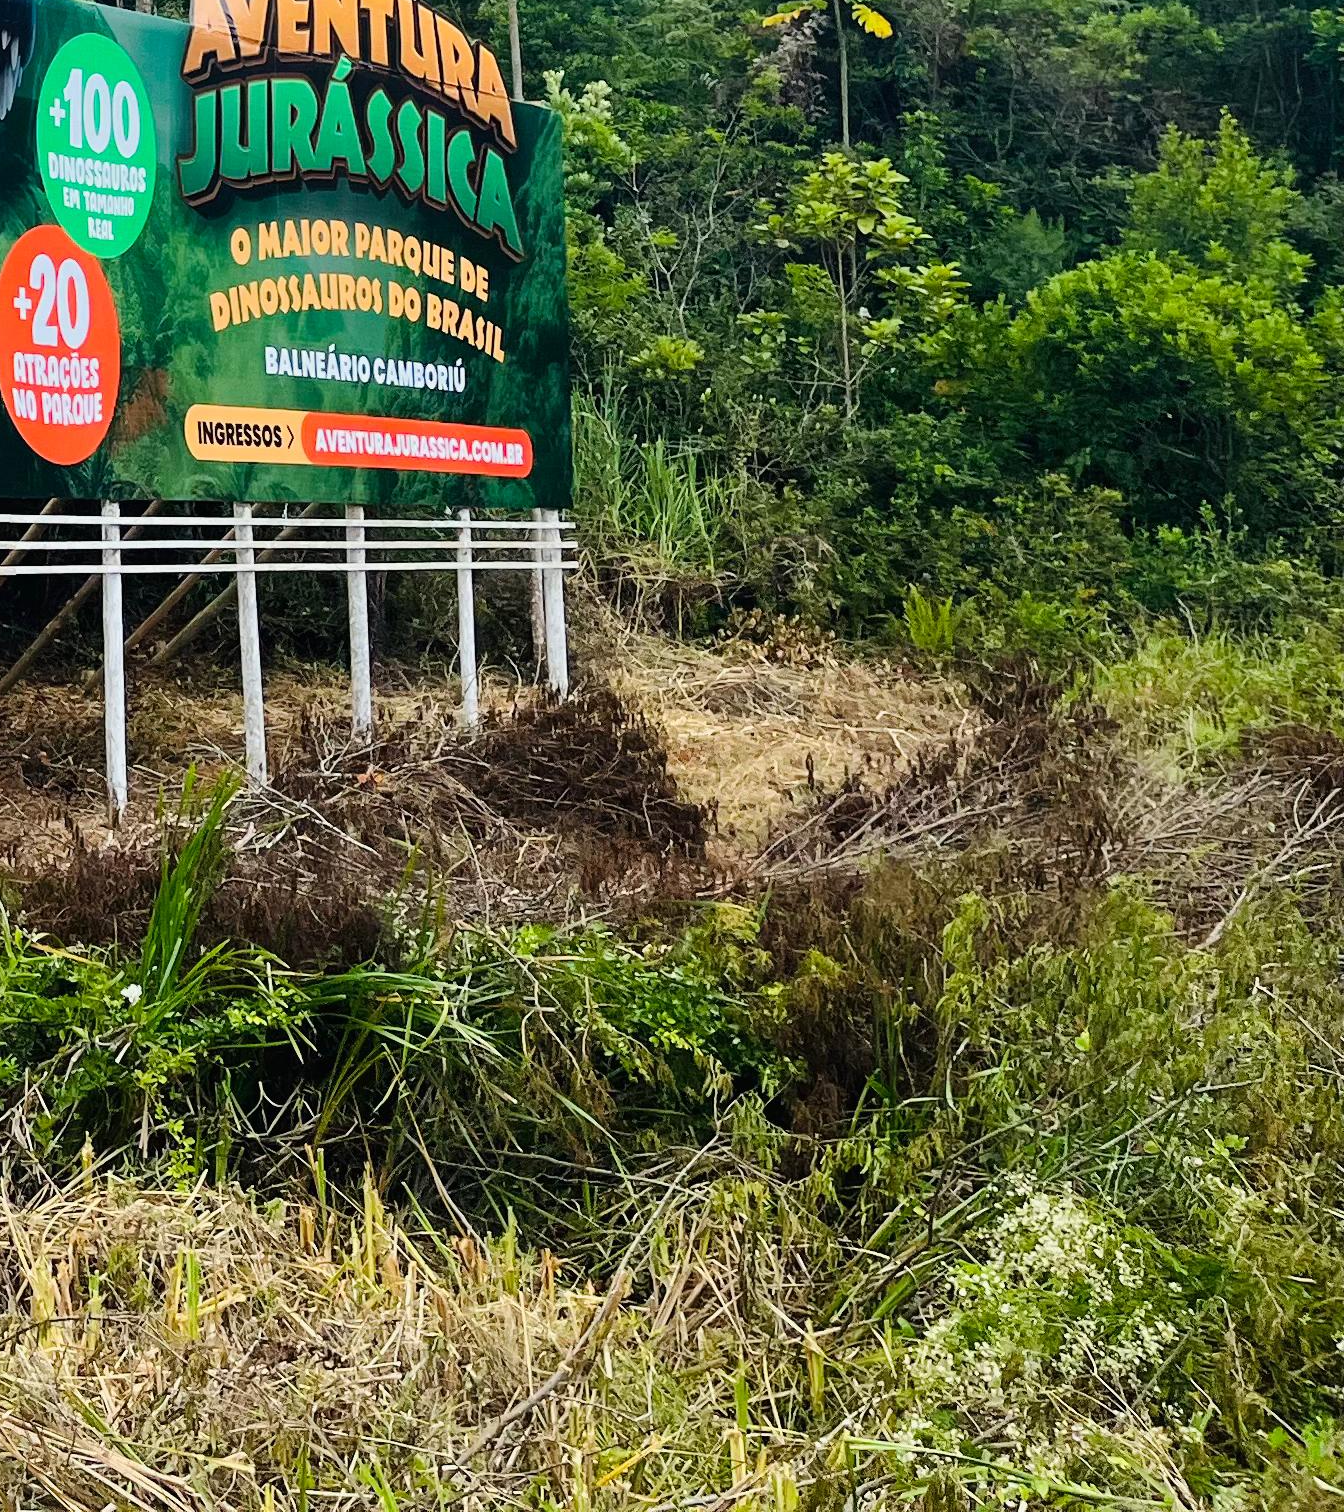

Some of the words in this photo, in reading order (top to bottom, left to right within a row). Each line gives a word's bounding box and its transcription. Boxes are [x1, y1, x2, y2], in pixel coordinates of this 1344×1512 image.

[48, 67, 140, 155] +100
[48, 155, 146, 192] DINOSSAUROS
[181, 57, 523, 254] JURÁSSICA
[63, 187, 81, 209] EM
[83, 191, 134, 217] TAMANHO
[87, 216, 114, 241] REAL
[231, 230, 251, 266] O
[259, 220, 349, 260] MAIOR
[355, 221, 454, 280] PARQUE
[461, 255, 489, 302] DE
[13, 253, 90, 350] +20
[210, 273, 382, 332] DINOSSAUROS
[388, 284, 420, 322] DO
[426, 301, 505, 363] BRASIL
[14, 346, 99, 390] ATRAÇÕES
[265, 344, 370, 383] BALNEÁRIO
[373, 358, 466, 393] CAMBORIÚ
[14, 386, 37, 417] NO
[42, 389, 103, 425] PARQUE
[197, 421, 282, 449] INGRESSOS
[316, 429, 524, 466] AVENTURAJURASSICA.COM.BR
